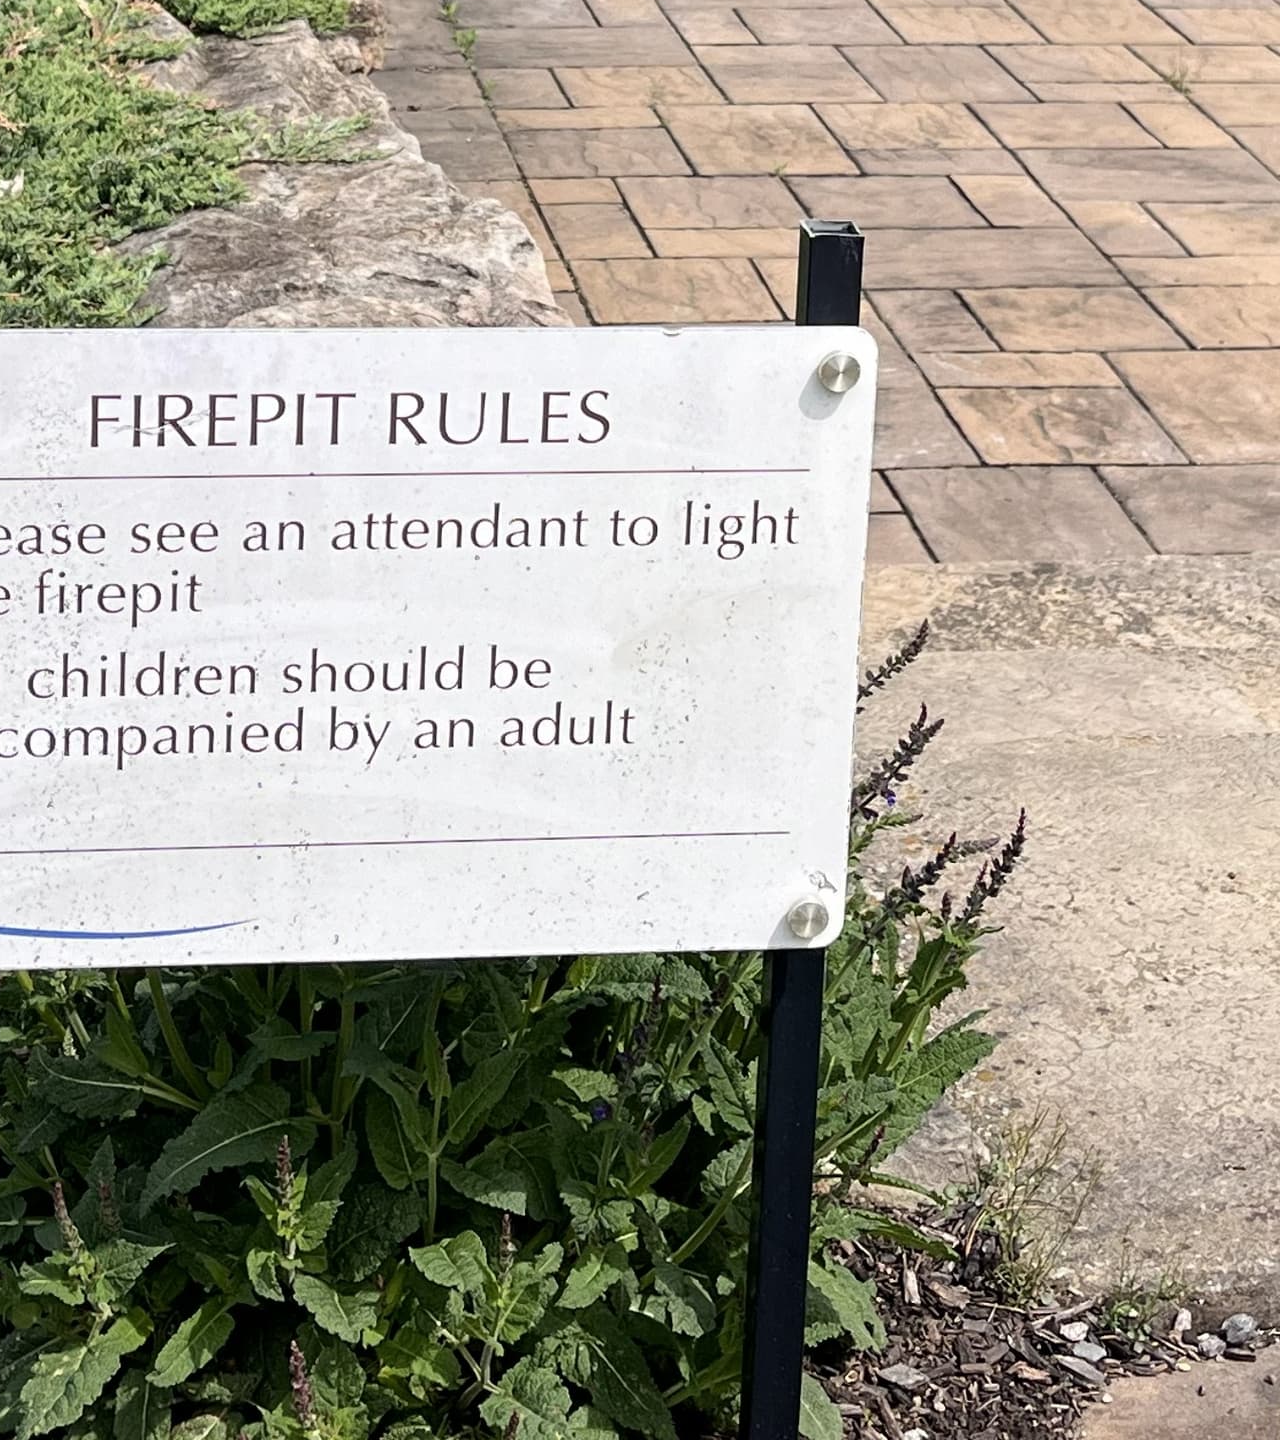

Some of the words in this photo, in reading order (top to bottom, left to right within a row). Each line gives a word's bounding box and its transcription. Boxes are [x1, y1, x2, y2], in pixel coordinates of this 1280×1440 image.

[90, 392, 357, 448] FIREPIT
[388, 390, 612, 446] RULES
[130, 521, 220, 555] see
[242, 520, 306, 553] an
[330, 501, 589, 551] attendant
[609, 510, 659, 548] to
[683, 498, 800, 562] light
[34, 567, 203, 629] firepit
[26, 648, 257, 700] children
[281, 644, 466, 695] should
[488, 643, 553, 691] be
[328, 705, 392, 766] by
[413, 717, 475, 750] an
[499, 699, 636, 748] adult
